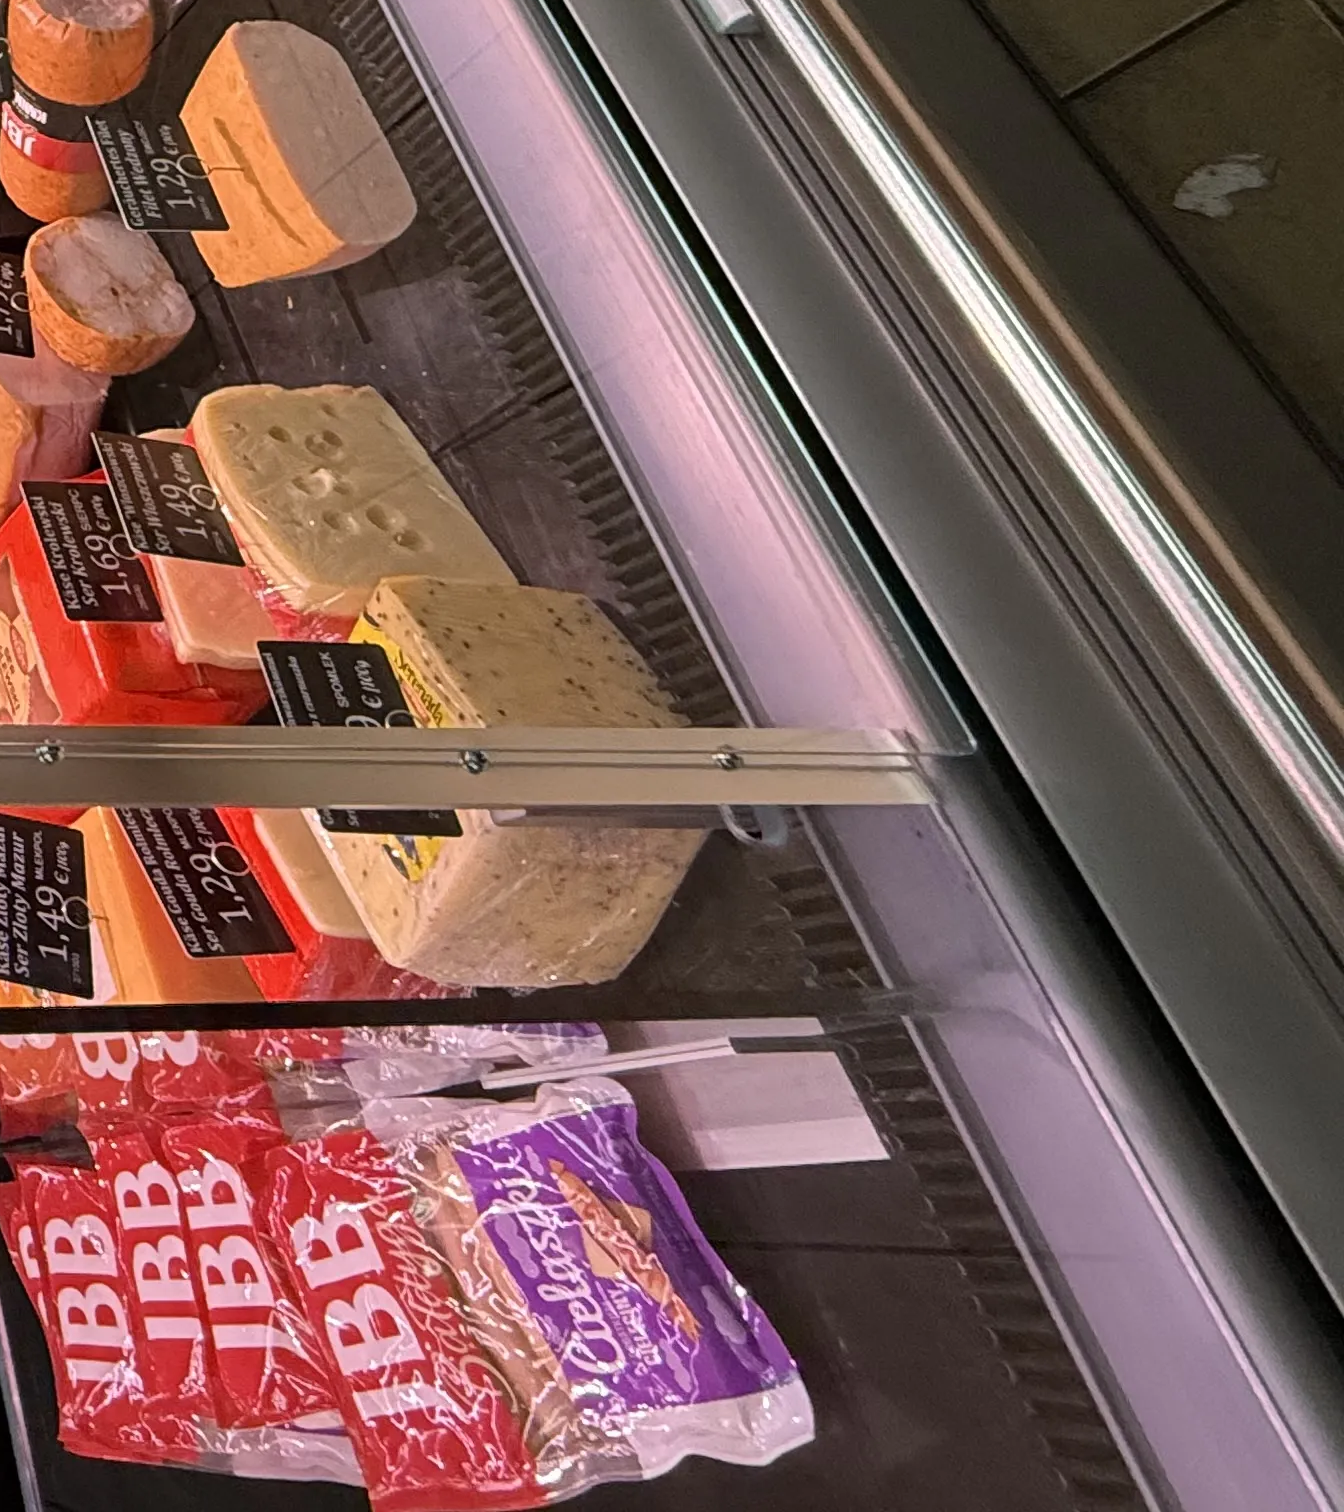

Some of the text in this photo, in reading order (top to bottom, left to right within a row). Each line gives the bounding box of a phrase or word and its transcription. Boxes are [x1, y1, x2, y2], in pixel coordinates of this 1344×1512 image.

[92, 118, 115, 146] Filet
[102, 147, 146, 227] Geräuchertes
[135, 188, 164, 219] Filet
[149, 157, 197, 210] 1,29
[67, 488, 93, 532] SIERPC
[158, 483, 209, 538] 1,49
[29, 495, 81, 610] Käse Krolewski
[49, 501, 100, 607] Ser Krolewski
[131, 521, 150, 551] Käse
[153, 529, 175, 555] Ser
[83, 534, 132, 596] 1,69
[318, 650, 350, 709] SPOMLEK
[360, 695, 383, 709] €
[162, 807, 192, 850] MLEKPO
[33, 830, 44, 880] MLEKPOL
[54, 870, 70, 884] €
[10, 831, 31, 978] Ser Zloty Mazur
[150, 867, 184, 914] Gouda
[173, 872, 210, 923] Gouda
[188, 851, 255, 925] 1,29
[35, 885, 70, 962] 1,49
[176, 917, 204, 953] Käse
[199, 924, 225, 953] Ser
